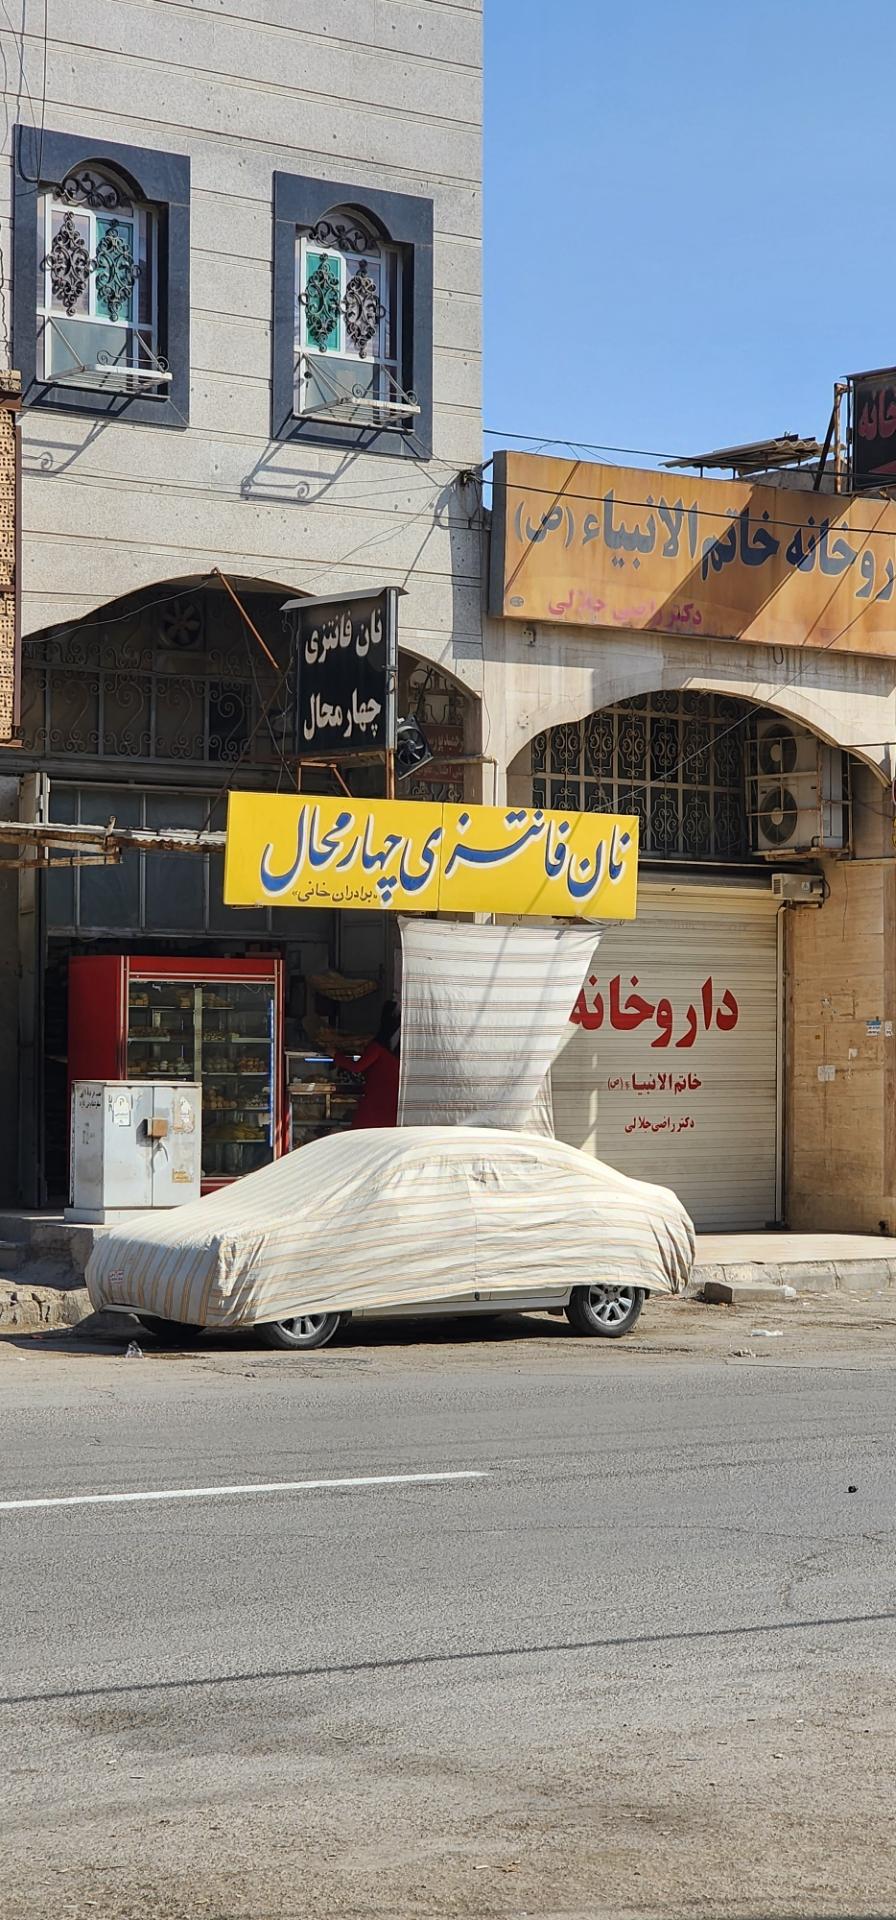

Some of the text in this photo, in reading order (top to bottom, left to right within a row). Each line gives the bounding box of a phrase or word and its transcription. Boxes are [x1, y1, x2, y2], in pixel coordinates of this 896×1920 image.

[514, 488, 896, 602] روخانه خاتم الانبیاء (ص)
[304, 608, 383, 665] نان فانتزی
[399, 807, 570, 894] فانتزی
[566, 824, 631, 900] نان
[568, 974, 739, 1048] داروخانه
[674, 1072, 702, 1096] خاتم
[624, 1115, 695, 1134] دکتر راضی جلالی
